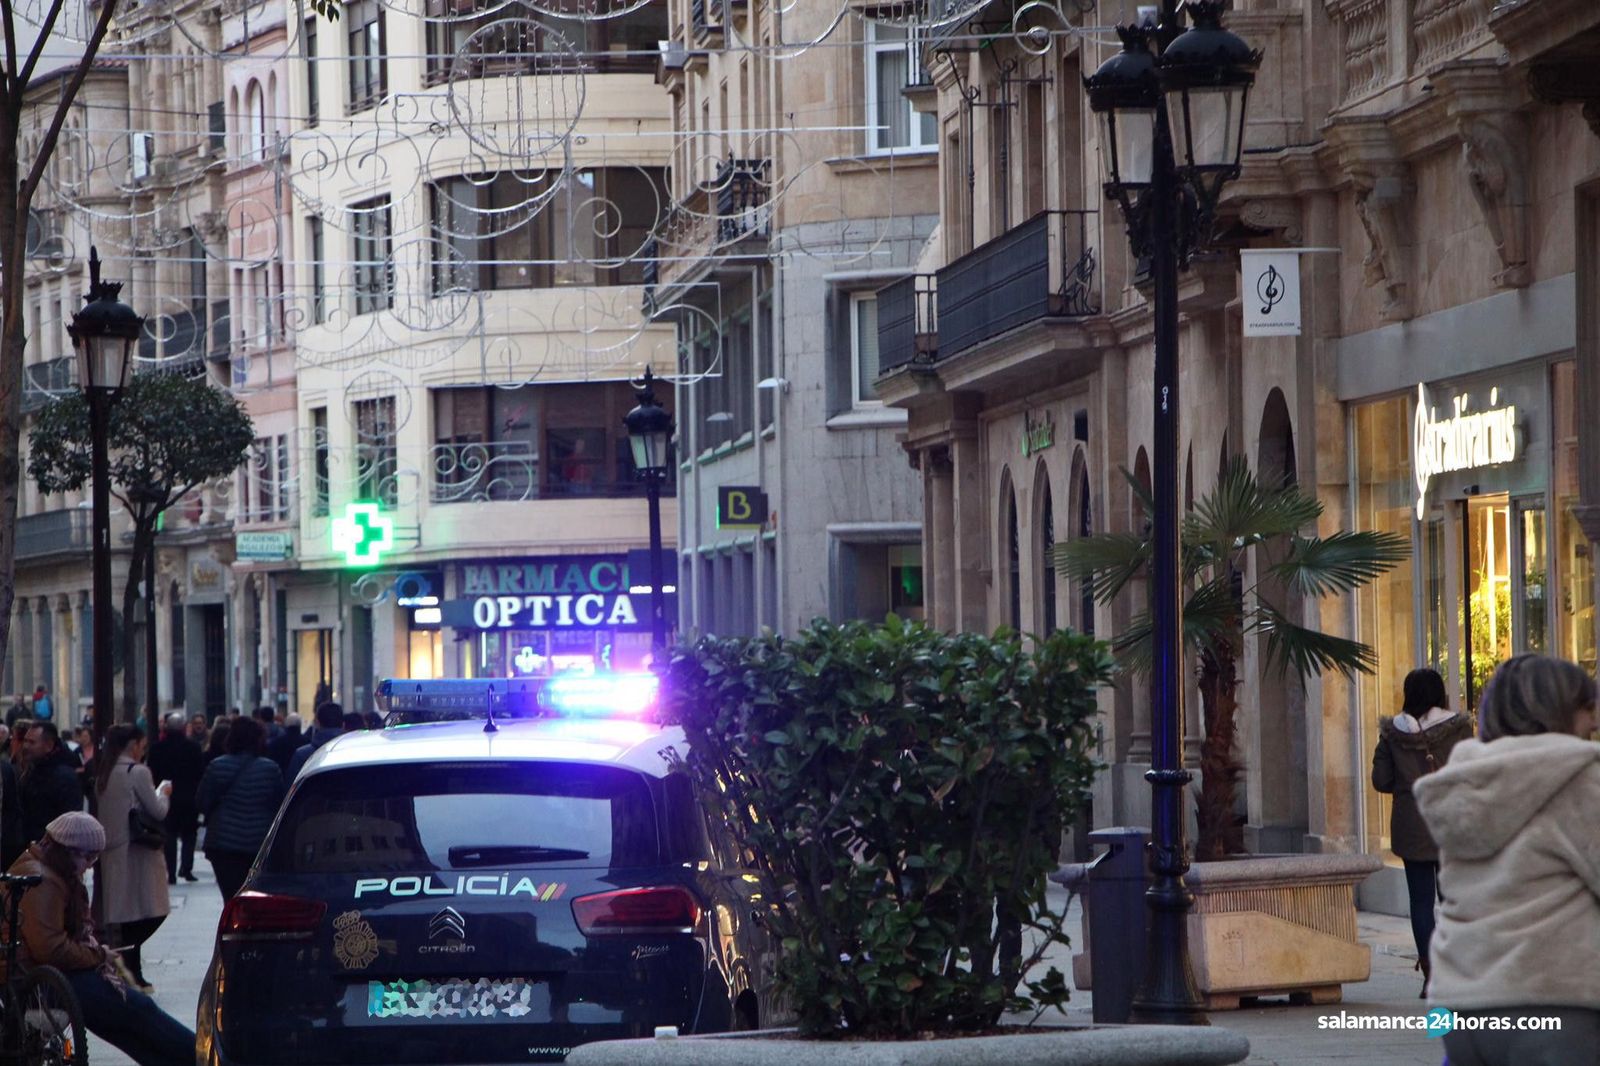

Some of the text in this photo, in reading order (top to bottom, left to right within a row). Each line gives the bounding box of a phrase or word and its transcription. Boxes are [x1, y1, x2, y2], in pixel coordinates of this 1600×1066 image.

[464, 562, 630, 594] FARMACI
[473, 594, 637, 628] OPTICA
[354, 872, 538, 899] POLICÍA
[528, 1047, 571, 1055] www.p
